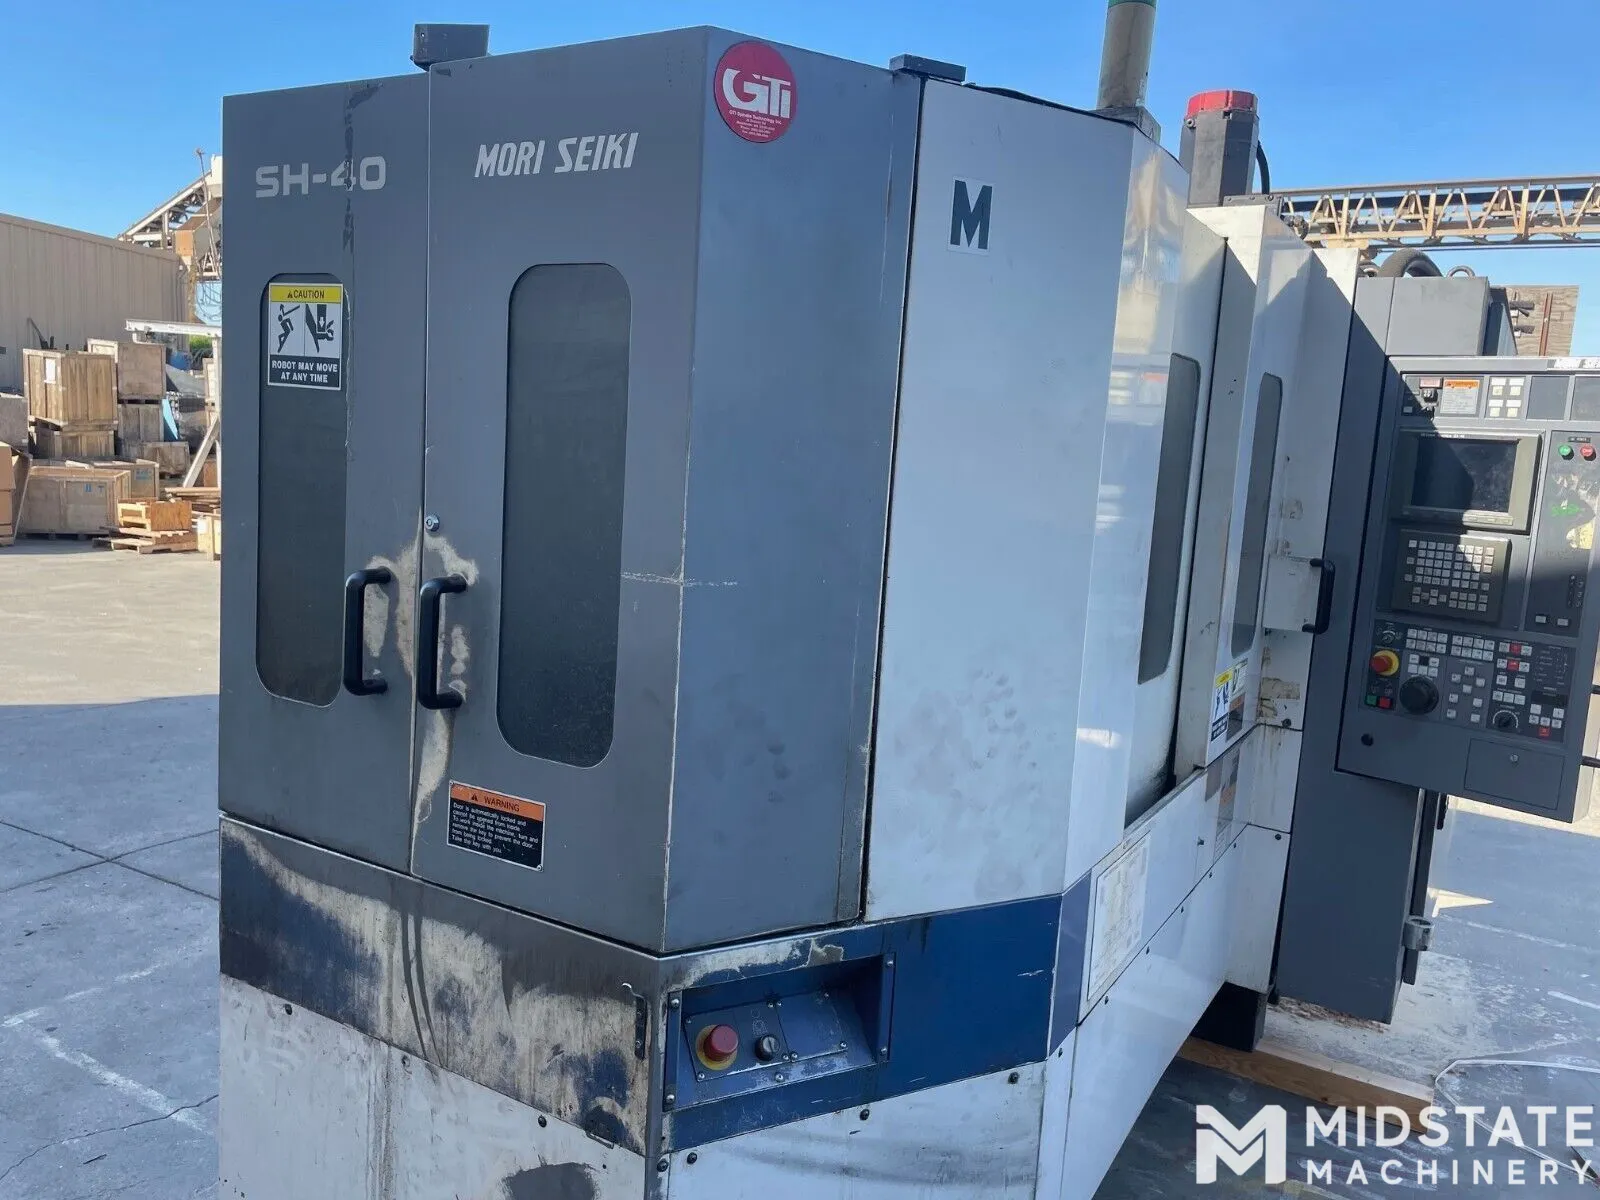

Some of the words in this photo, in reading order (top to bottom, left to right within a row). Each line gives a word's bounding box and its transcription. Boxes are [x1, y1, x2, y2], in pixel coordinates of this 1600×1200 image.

[474, 140, 545, 178] MORI
[554, 132, 639, 174] SEIKI
[255, 155, 387, 198] SH-40
[950, 180, 993, 249] M
[294, 289, 324, 298] CAUTION
[272, 360, 296, 369] ROBOT
[298, 362, 314, 371] MAY
[316, 363, 338, 372] MOVE
[281, 372, 290, 380] AT
[292, 373, 308, 382] ANY
[310, 374, 328, 383] TIME
[484, 796, 520, 812] WARNING
[453, 802, 463, 810] Door
[471, 808, 499, 820] automatically
[501, 816, 516, 824] locked
[477, 816, 494, 825] opened
[452, 828, 462, 836] from
[464, 832, 476, 840] being
[452, 834, 462, 842] Take
[494, 834, 511, 842] prevent
